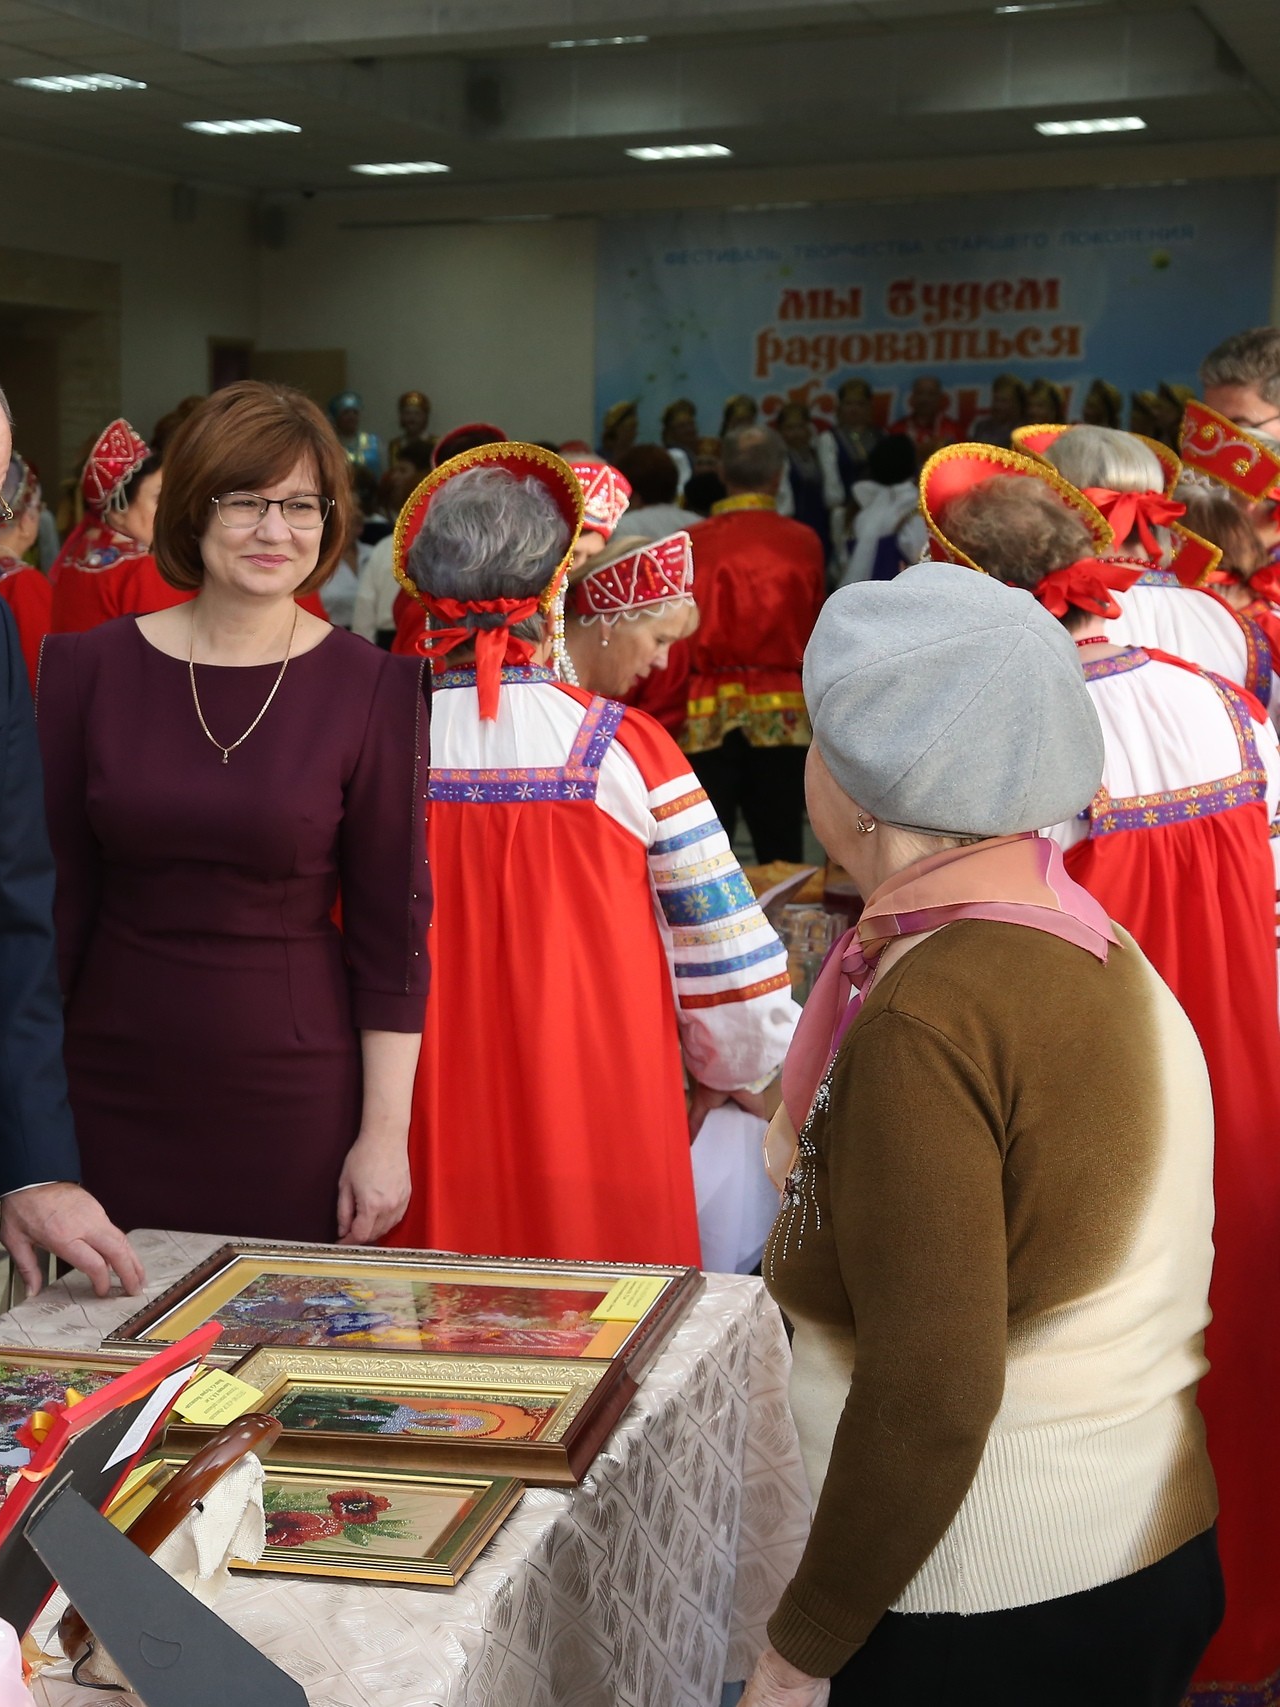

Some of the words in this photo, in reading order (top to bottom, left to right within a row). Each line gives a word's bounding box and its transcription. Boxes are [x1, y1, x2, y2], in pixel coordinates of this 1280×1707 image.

[664, 246, 781, 266] ФЕСТИВАЛЬ
[795, 240, 923, 260] ТВОРЧЕСТВА
[937, 232, 1049, 253] СТАРШЕГО
[1061, 225, 1195, 246] ПОКОЛЕНИЯ
[888, 278, 1059, 324] будем
[755, 326, 1081, 378] радоваться
